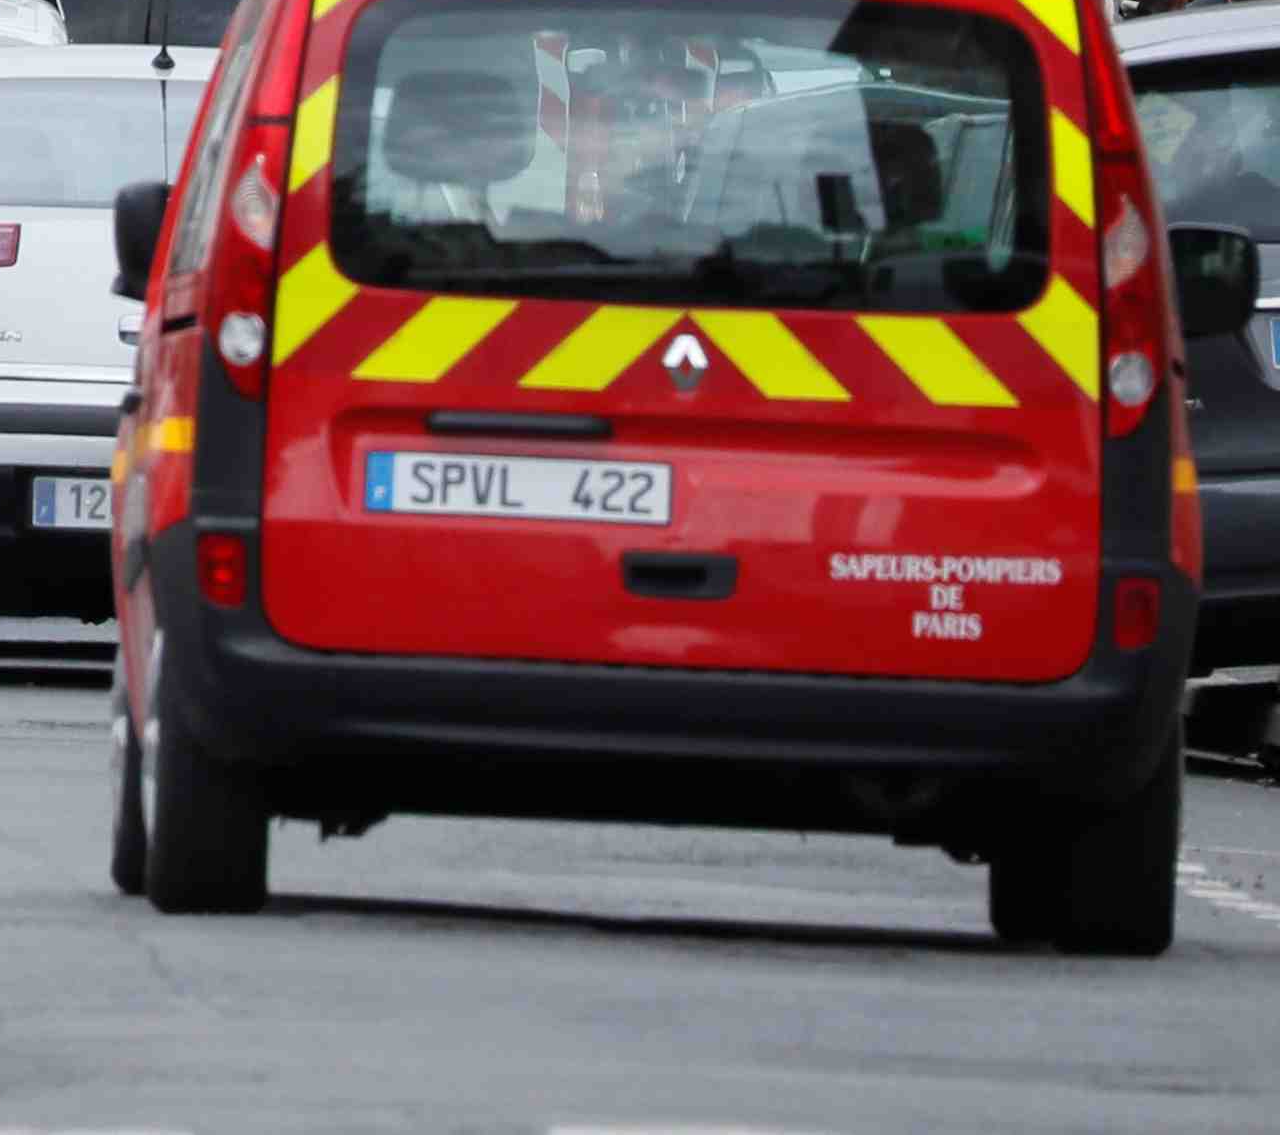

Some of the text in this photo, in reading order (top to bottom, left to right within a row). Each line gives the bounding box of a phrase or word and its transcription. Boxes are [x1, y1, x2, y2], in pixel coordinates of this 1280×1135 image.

[410, 462, 655, 514] SPVL 422
[830, 553, 1062, 585] SAPEURS-POMPIERS
[930, 584, 965, 610] DE
[912, 612, 982, 640] PARIS
